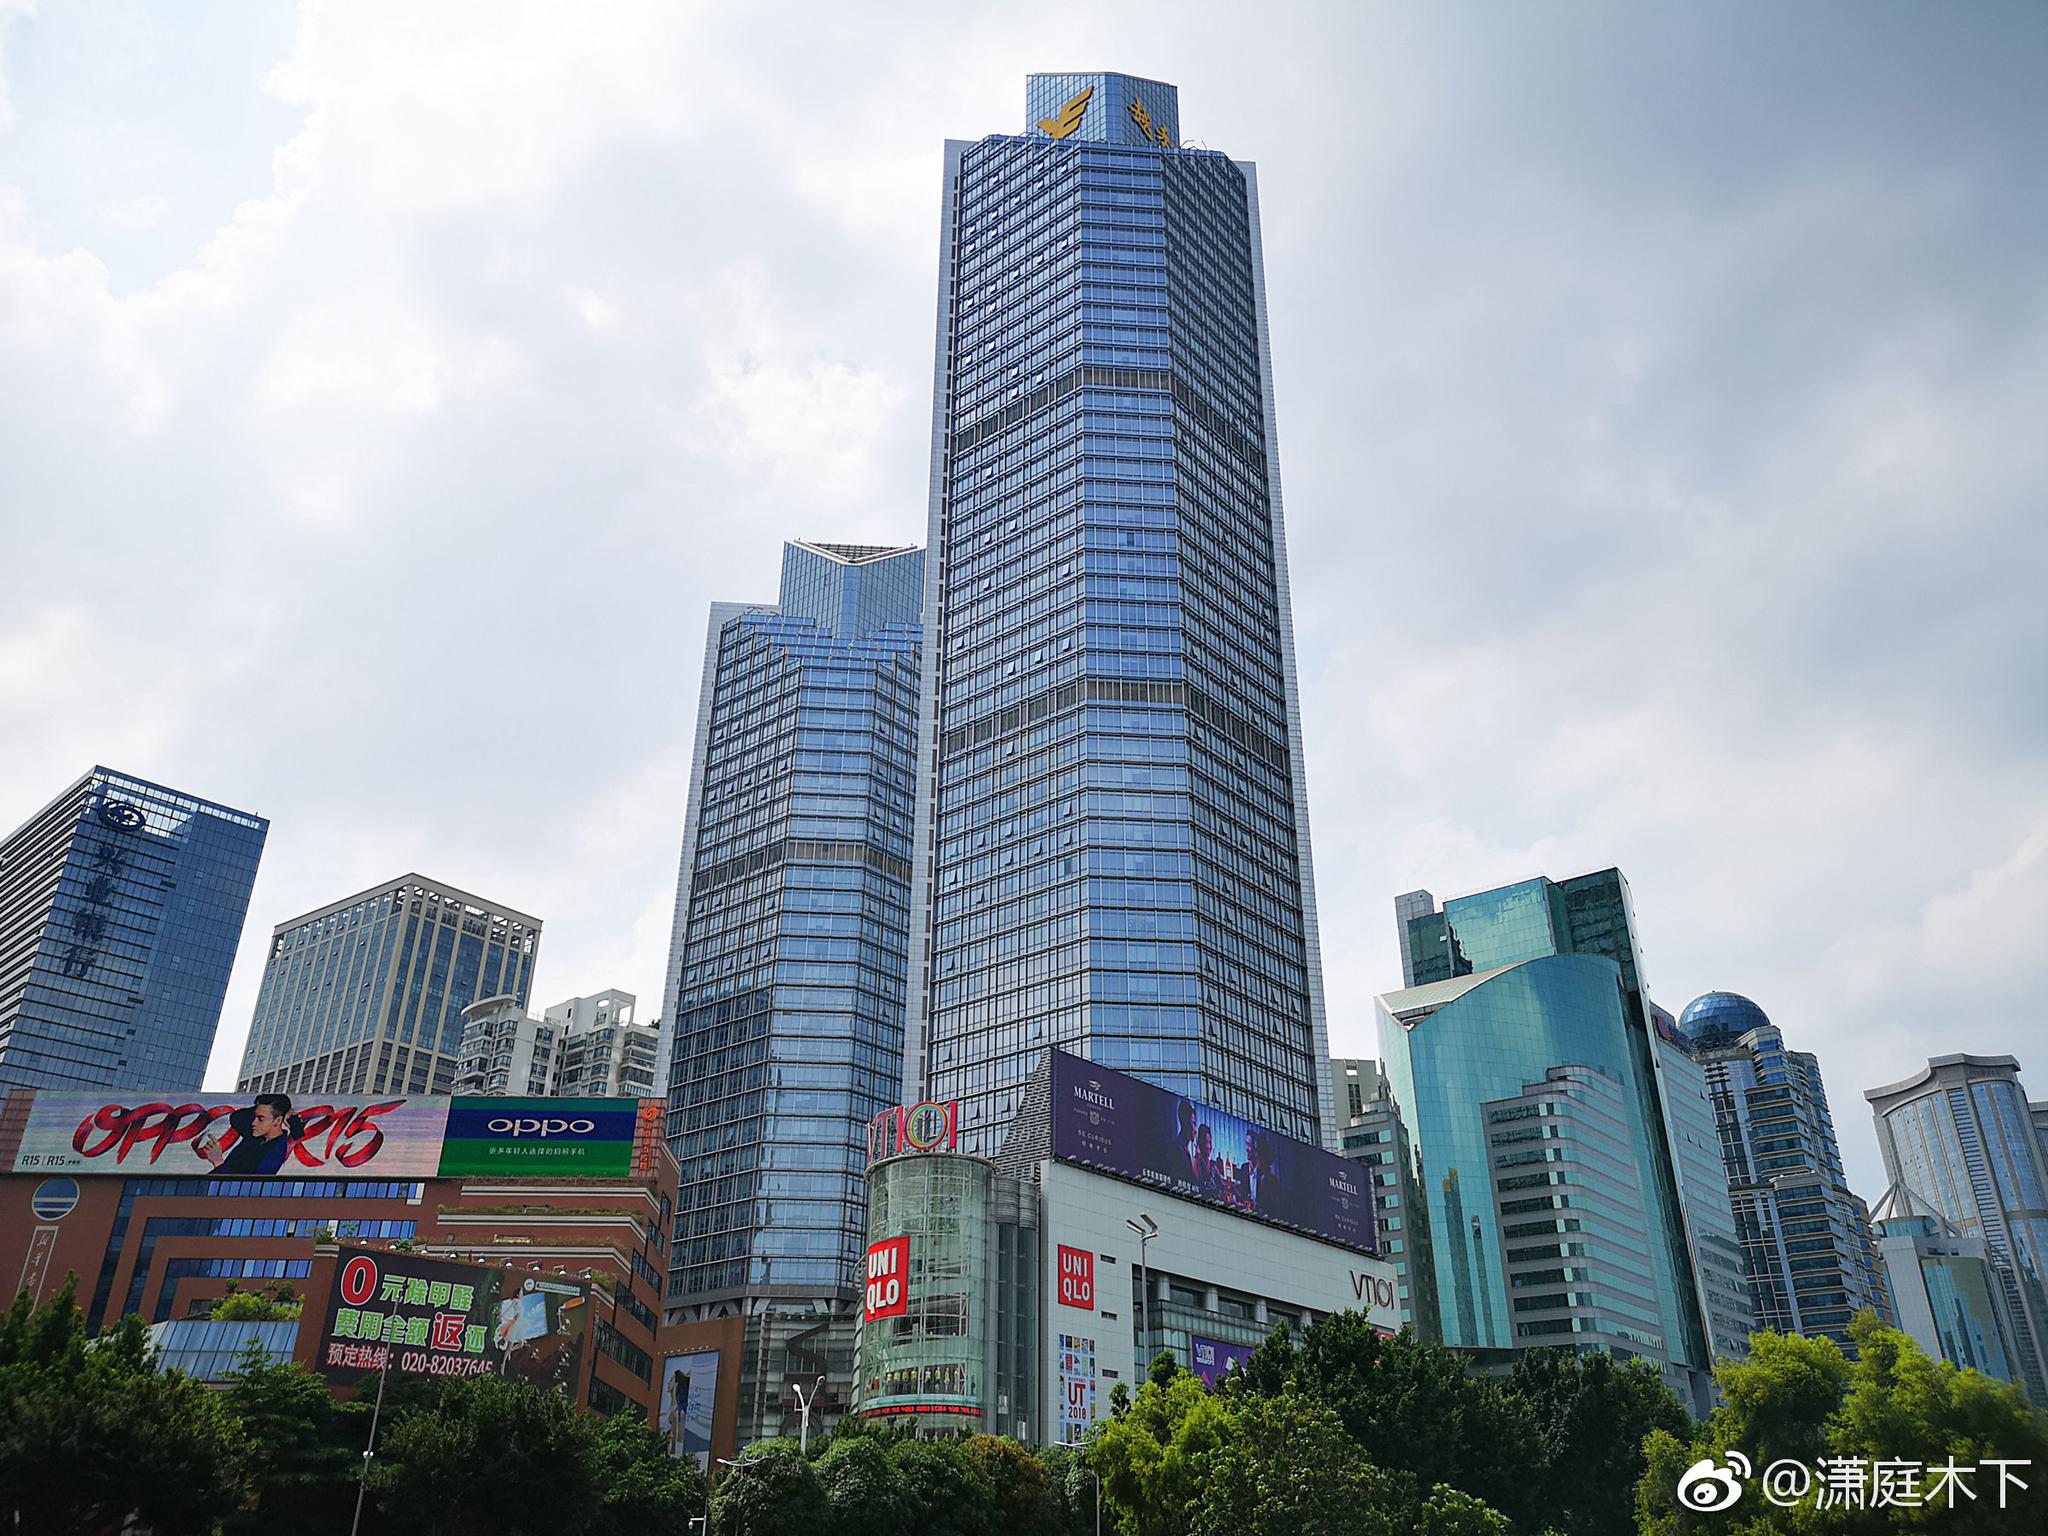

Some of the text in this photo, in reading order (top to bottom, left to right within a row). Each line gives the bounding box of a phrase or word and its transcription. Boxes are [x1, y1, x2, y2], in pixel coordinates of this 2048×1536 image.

[1073, 1086, 1115, 1110] MARTELL
[72, 1099, 407, 1167] OPPO R15
[21, 1155, 40, 1166] R15
[46, 1155, 65, 1166] R15
[1328, 1176, 1359, 1196] MARTELL
[868, 1247, 898, 1280] UNI
[1063, 1253, 1088, 1278] UNI
[866, 1278, 900, 1315] QLO
[1063, 1277, 1090, 1302] QLO
[331, 1308, 487, 1354] 费用全额返还
[1068, 1382, 1086, 1407] UT
[1068, 1407, 1087, 1420] 2018
